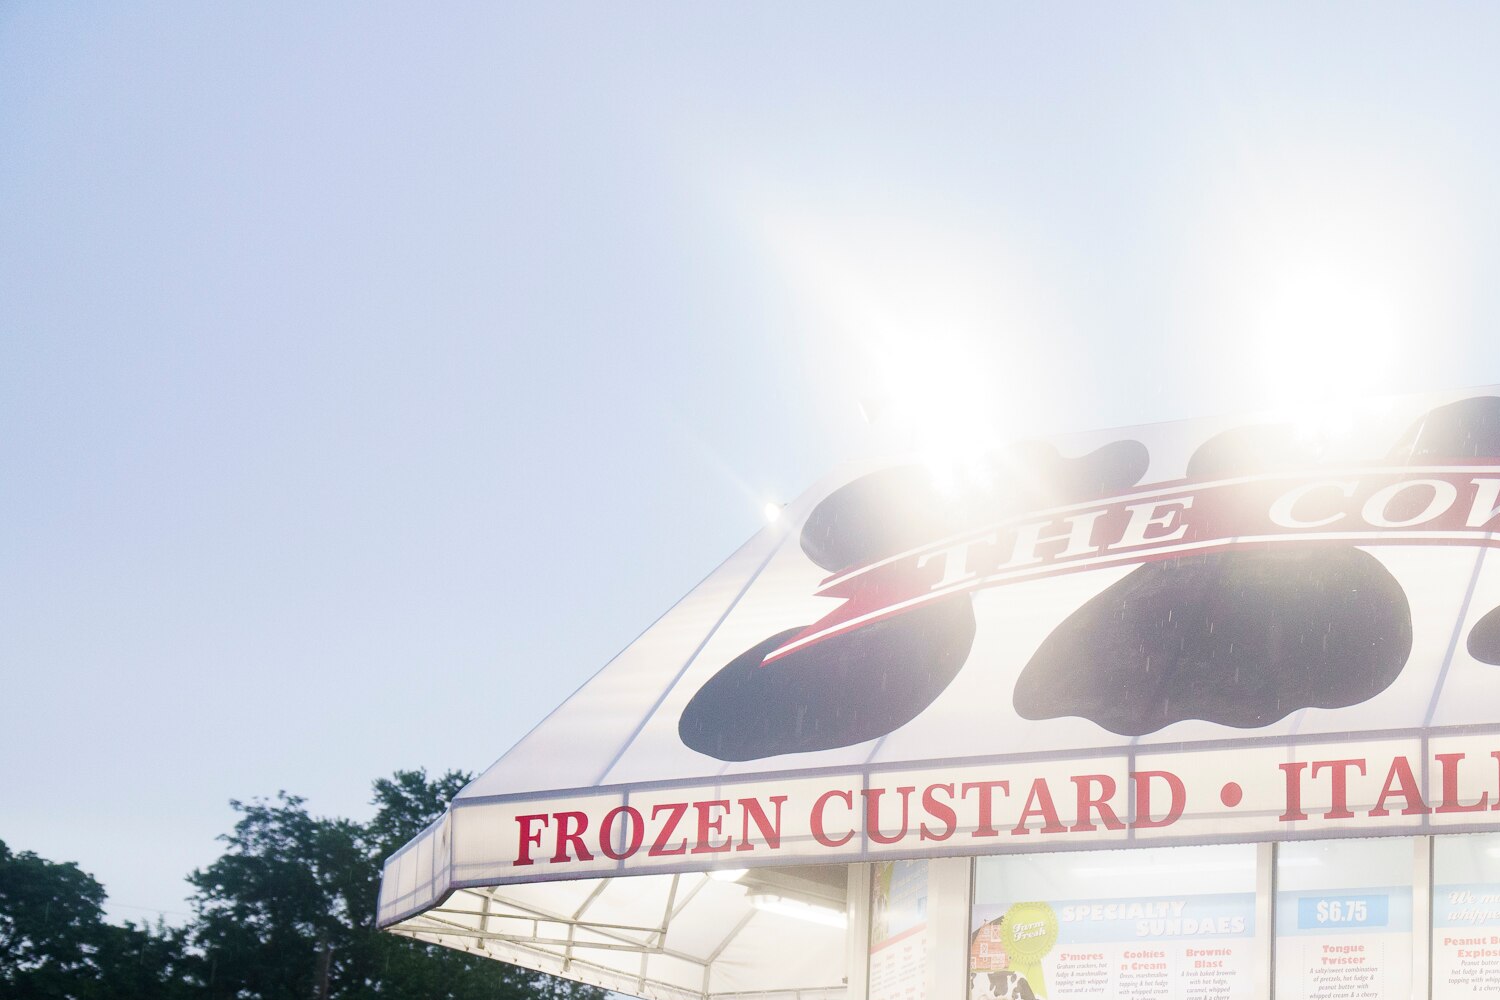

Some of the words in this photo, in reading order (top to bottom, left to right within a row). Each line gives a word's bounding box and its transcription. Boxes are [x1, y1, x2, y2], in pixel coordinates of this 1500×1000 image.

[917, 496, 1195, 590] THE
[513, 795, 788, 867] FROZEN
[809, 770, 1188, 848] CUSTARD
[1448, 890, 1477, 904] We
[1062, 901, 1188, 922] SPECIALTY
[1316, 899, 1368, 923] $6.75
[1013, 921, 1045, 932] Farm
[1136, 917, 1247, 937] SUNDAES
[1013, 928, 1047, 942] Fresh
[1444, 937, 1487, 946] Peanut
[1185, 948, 1232, 957] Brownie
[1322, 944, 1365, 954] Tongue
[1059, 952, 1105, 961] S'mores
[1123, 950, 1166, 959] Cookies
[1194, 960, 1224, 969] Blast
[1321, 956, 1366, 965] Twister
[1461, 959, 1480, 967] Peanut
[1121, 963, 1128, 971] n
[1131, 961, 1168, 971] Cream
[1462, 968, 1478, 976] fudge
[1056, 979, 1074, 987] topping
[1088, 977, 1109, 986] whipped
[1154, 979, 1169, 987] fudge
[1320, 975, 1342, 983] pretzels,
[1354, 974, 1369, 982] fudge
[1449, 977, 1470, 985] topping
[1088, 986, 1105, 994] cherry
[1131, 988, 1153, 997] whipped
[1208, 986, 1231, 994] whipped
[1318, 984, 1337, 992] peanut
[1310, 992, 1332, 1000] whipped
